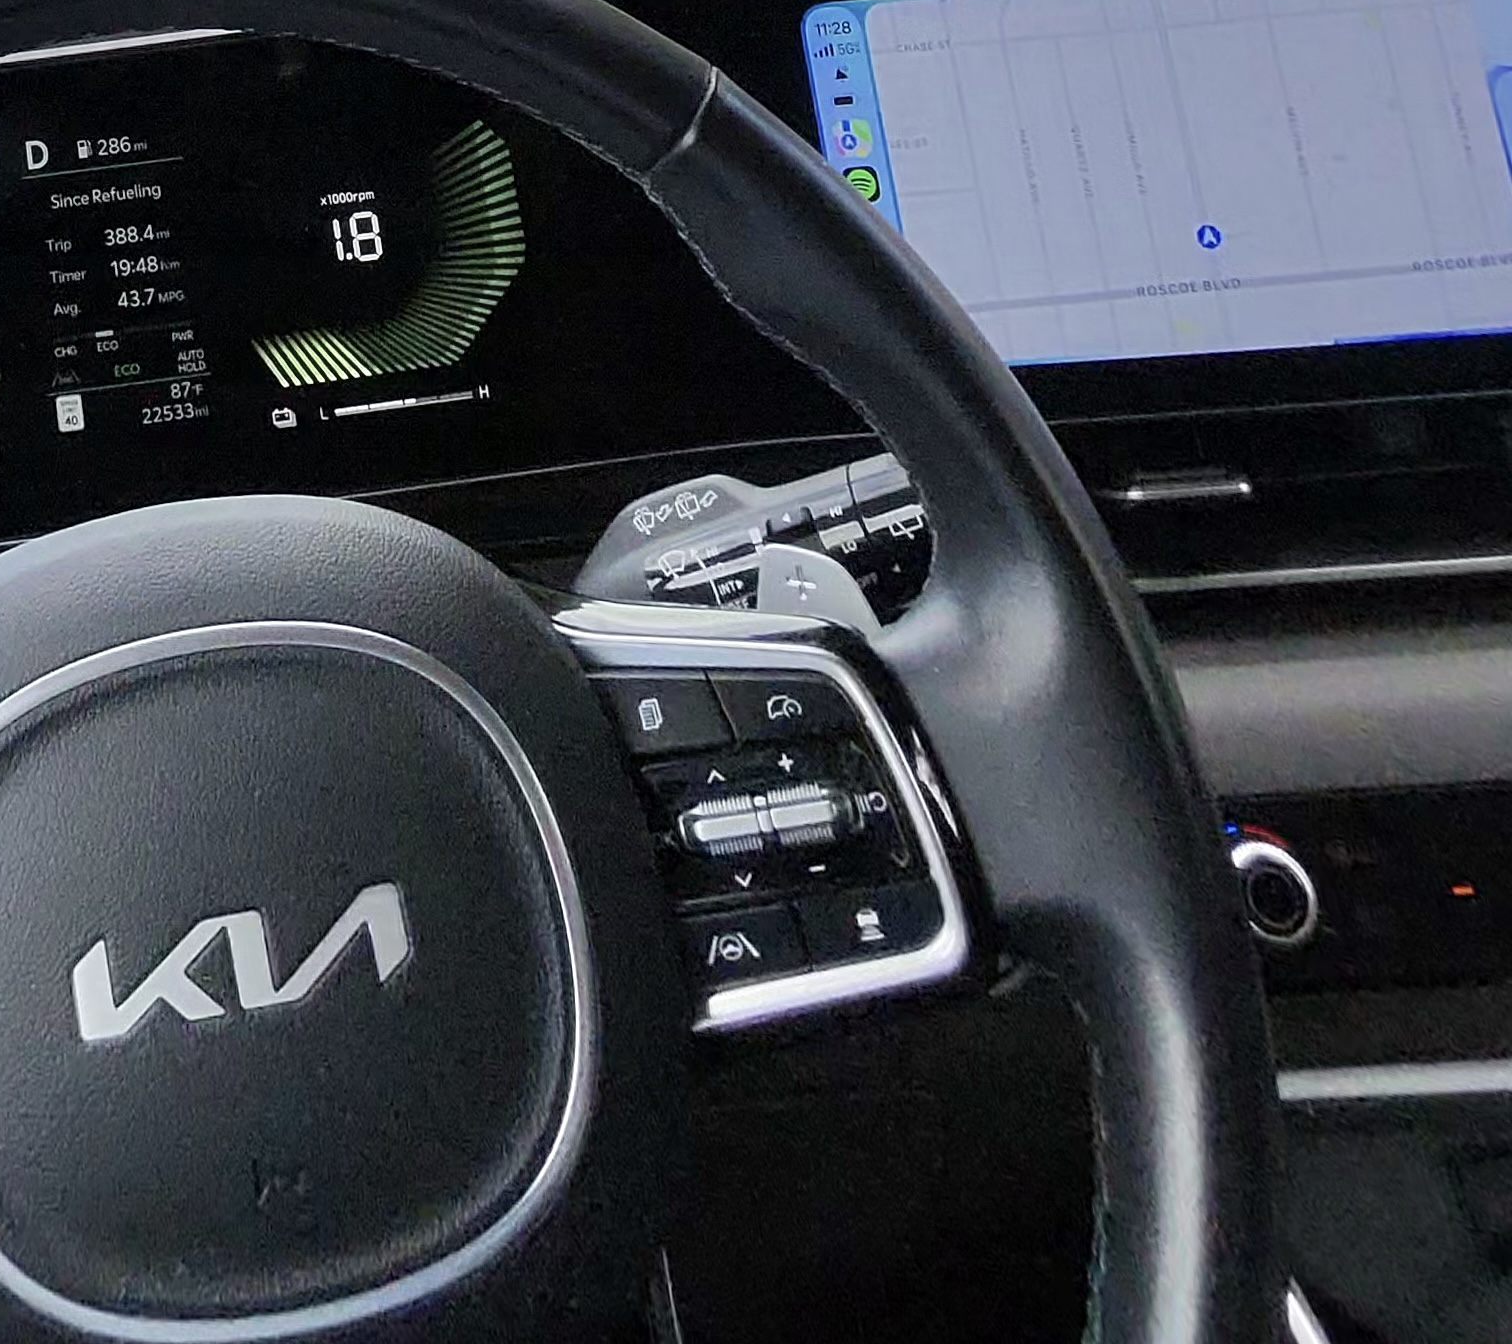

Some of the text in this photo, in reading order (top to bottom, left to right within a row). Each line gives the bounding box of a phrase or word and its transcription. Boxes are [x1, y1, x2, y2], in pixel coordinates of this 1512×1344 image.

[815, 21, 852, 37] 11:28
[25, 136, 131, 170] D 286
[50, 184, 162, 209] Since Refueling
[320, 190, 375, 207] x1000rpm
[332, 211, 383, 262] 1.8
[45, 238, 72, 253] Trip
[49, 269, 87, 284] Timer
[1136, 277, 1242, 298] ROSCOE BLVD
[53, 288, 185, 317] Avg. 43.7 MPG
[54, 330, 194, 358] CHG ECO PWR
[177, 348, 205, 361] AUTO
[114, 363, 140, 377] ECO
[178, 360, 207, 373] HOLD
[320, 384, 490, 421] L H
[65, 415, 79, 426] 40
[829, 505, 843, 518] HI
[841, 540, 858, 554] LO
[72, 882, 411, 1042] KIA
